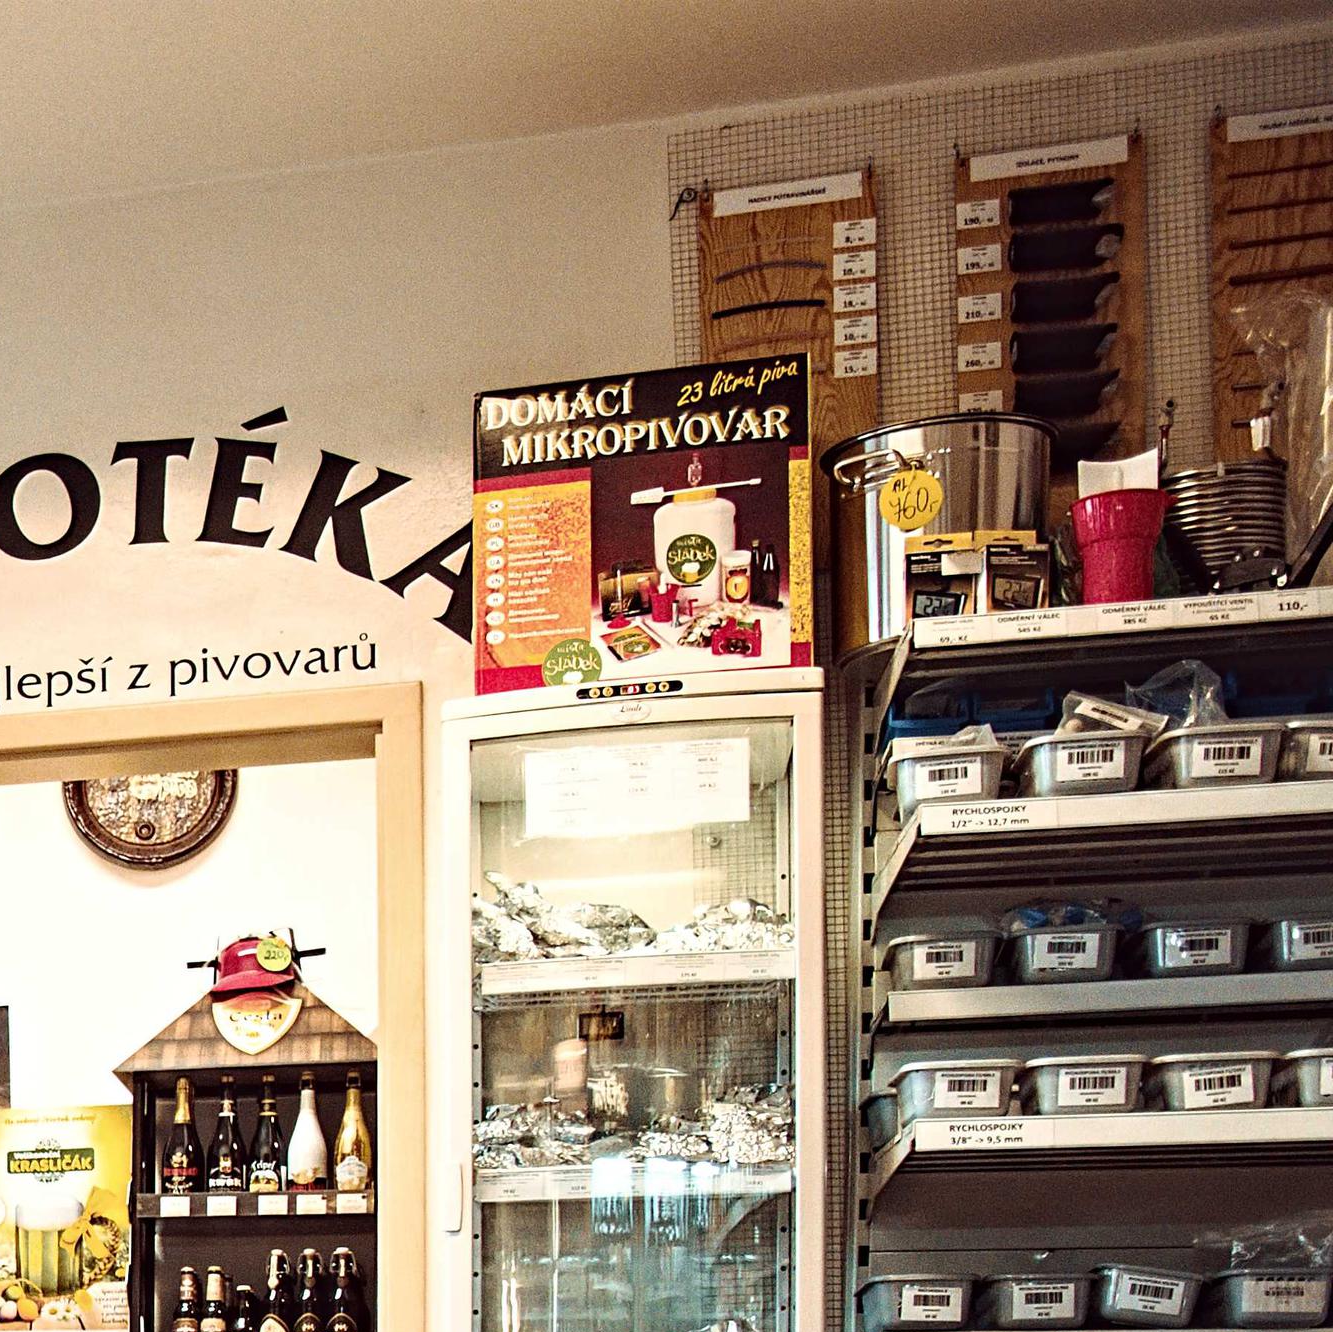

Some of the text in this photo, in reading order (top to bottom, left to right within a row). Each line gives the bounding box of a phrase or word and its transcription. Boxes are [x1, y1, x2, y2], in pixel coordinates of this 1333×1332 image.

[677, 360, 798, 407] 23 litrů piva
[483, 379, 634, 431] DOMÁCÍ
[501, 406, 791, 468] MIKROPIVOVAR
[1102, 603, 1168, 615] ODMĚRNÝ VÁLEC
[1277, 601, 1309, 612] 110,-
[997, 612, 1061, 624] ODMĚRNÝ VÁLEC
[127, 658, 151, 692] z
[169, 630, 378, 697] pivovarů
[951, 804, 1027, 817] RYCHLOSPOJKY
[987, 818, 1009, 828] 12,7
[1010, 817, 1030, 826] mm
[949, 1122, 1024, 1133] RYCHLOSPOJKY
[987, 1136, 1002, 1145] 9,5
[1004, 1135, 1023, 1143] mm
[9, 1153, 93, 1173] KRASLIČÁK
